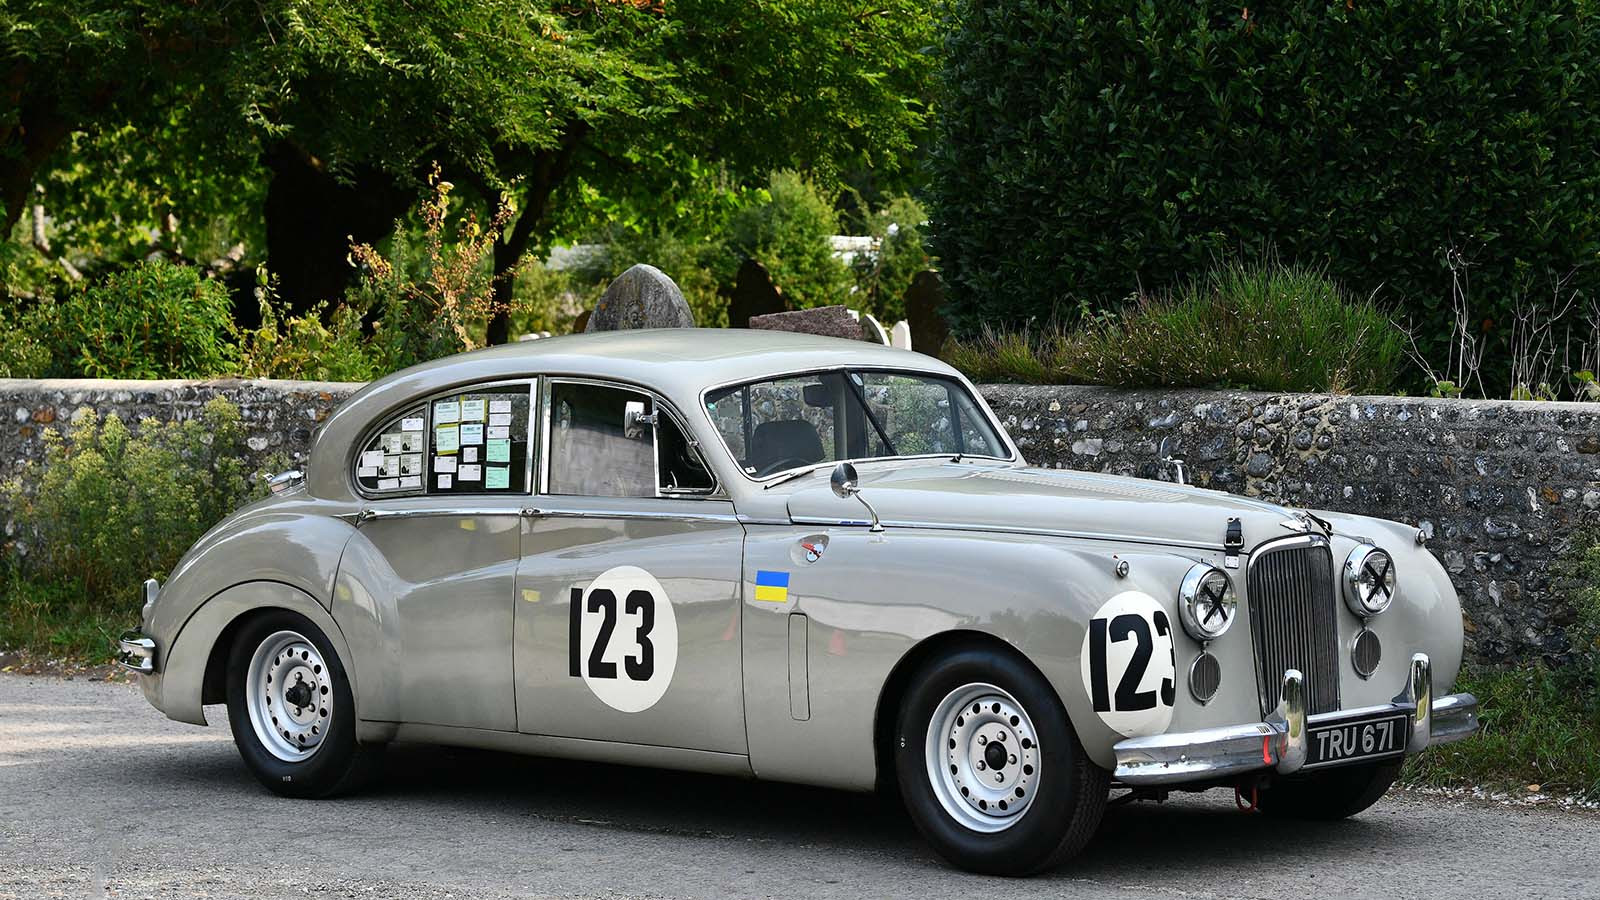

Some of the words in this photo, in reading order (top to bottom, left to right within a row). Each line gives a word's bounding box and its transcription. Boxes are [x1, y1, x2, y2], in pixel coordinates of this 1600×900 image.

[569, 588, 655, 681] 123
[1317, 726, 1357, 760] TRU
[1362, 720, 1394, 753] 671
